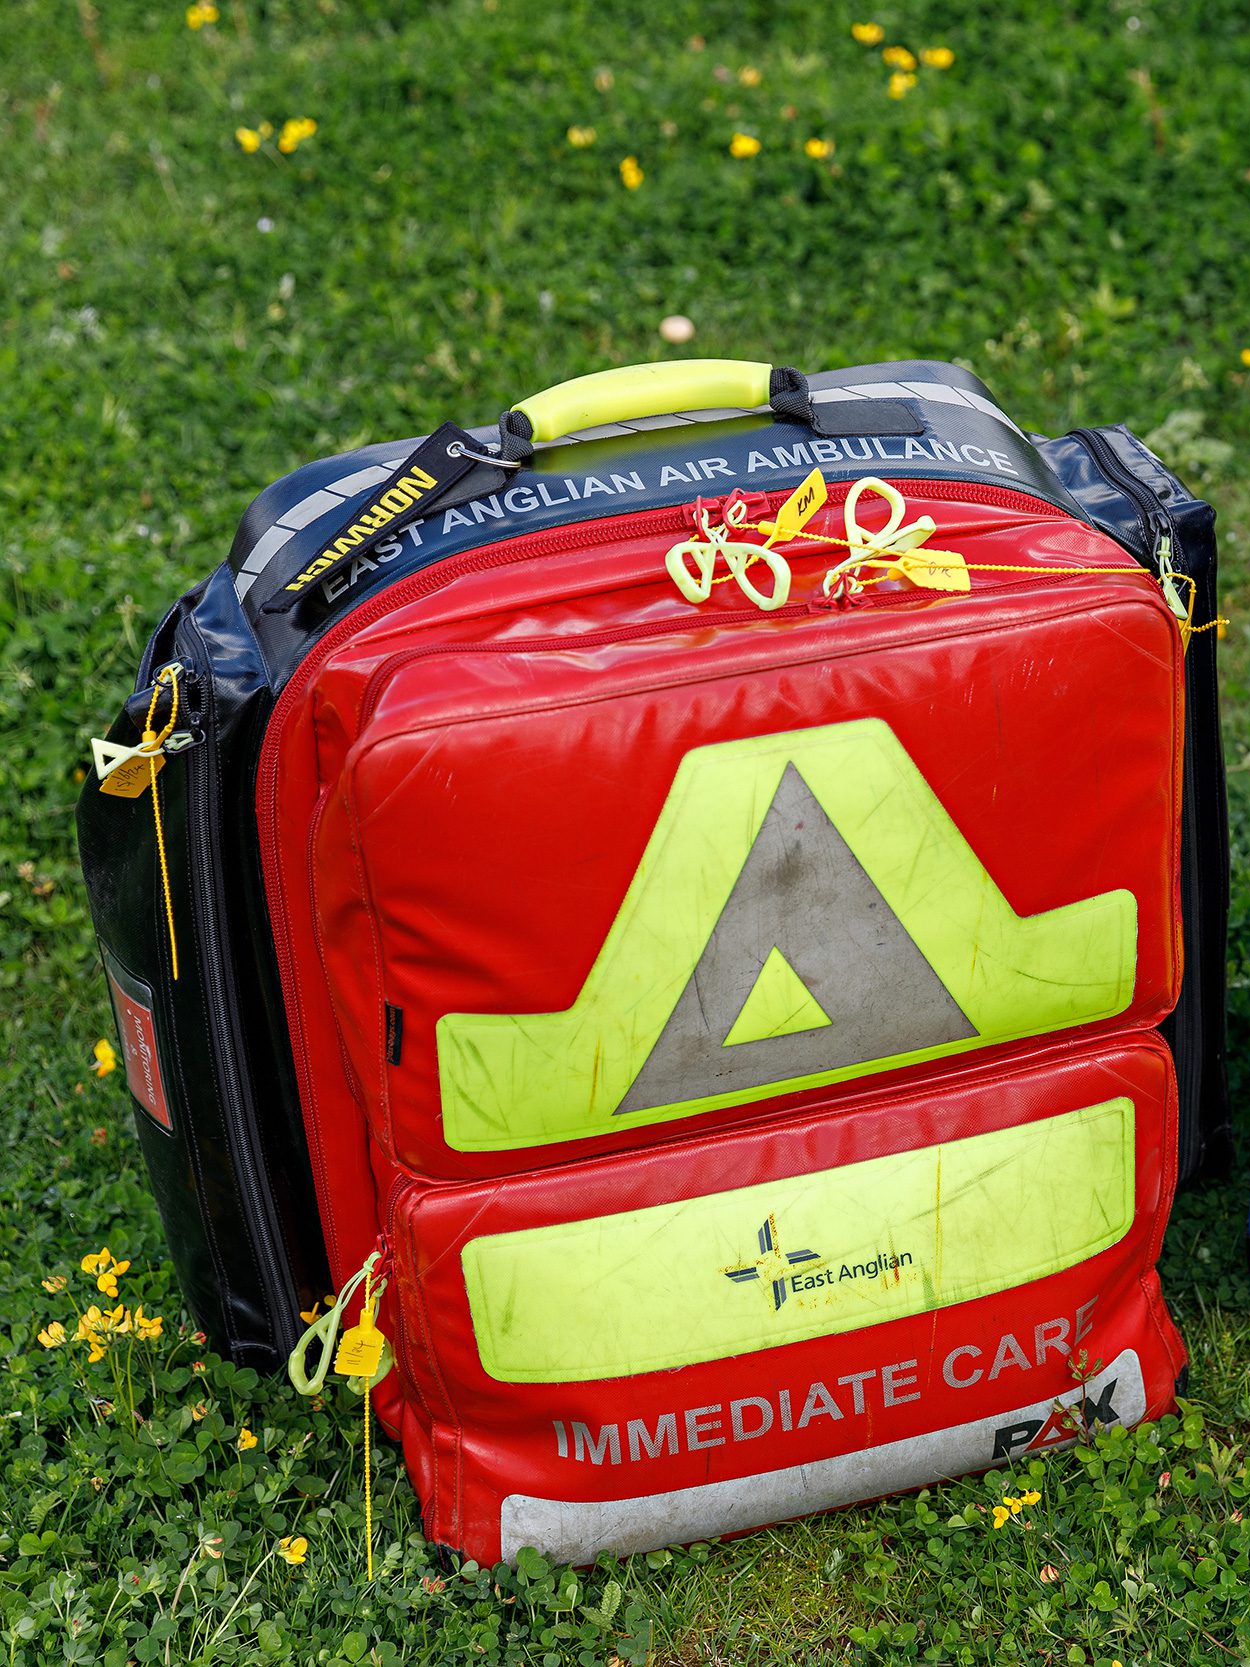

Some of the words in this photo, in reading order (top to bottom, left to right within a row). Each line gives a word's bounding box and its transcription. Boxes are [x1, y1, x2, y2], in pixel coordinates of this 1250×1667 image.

[285, 465, 438, 592] NORWICH
[320, 518, 425, 603] EAST
[442, 470, 646, 534] ANGLIAN
[660, 456, 735, 487] AIR
[747, 436, 1019, 476] AMBULANCE
[133, 1015, 157, 1105] MONITORING
[791, 1268, 835, 1294] East
[838, 1251, 913, 1283] Anglian
[552, 1358, 921, 1466] IMMEDIATE
[942, 1294, 1100, 1389] CARE
[991, 1377, 1121, 1460] PAX
